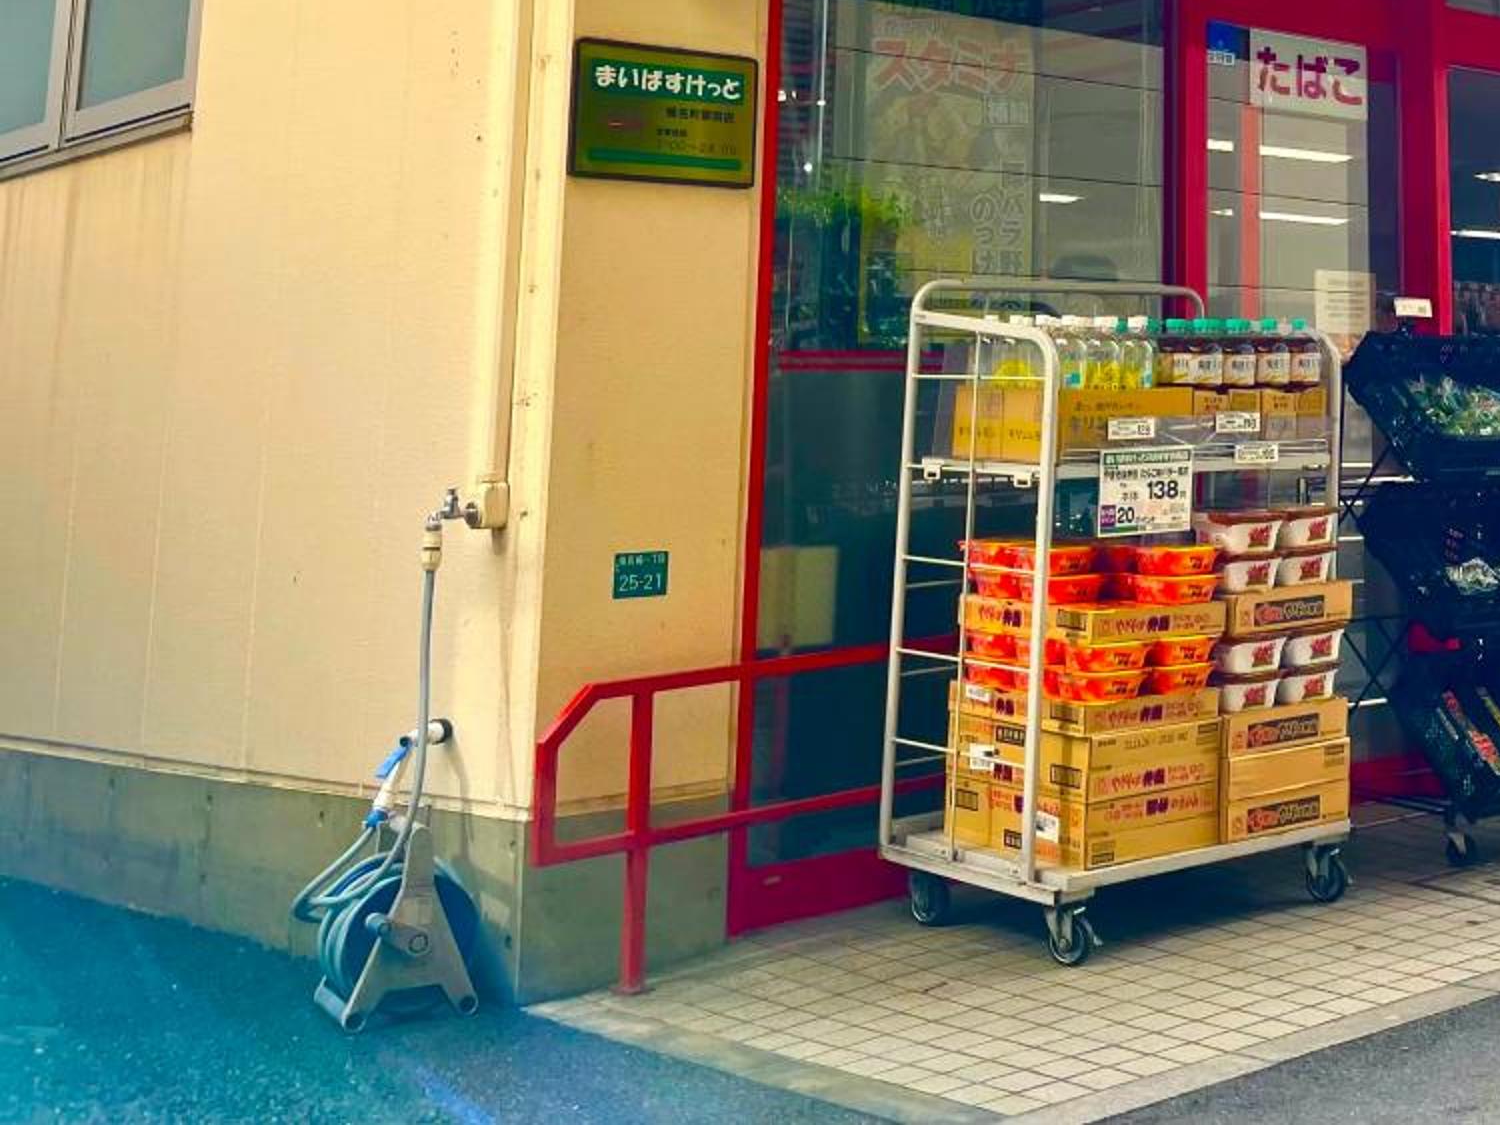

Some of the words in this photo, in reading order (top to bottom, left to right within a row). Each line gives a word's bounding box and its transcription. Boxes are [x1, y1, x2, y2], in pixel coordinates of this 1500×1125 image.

[595, 64, 741, 100] まいばすけっと
[1256, 46, 1363, 105] たばこ
[1146, 480, 1179, 500] 138
[1117, 507, 1135, 524] 20
[619, 573, 662, 592] 25-21
